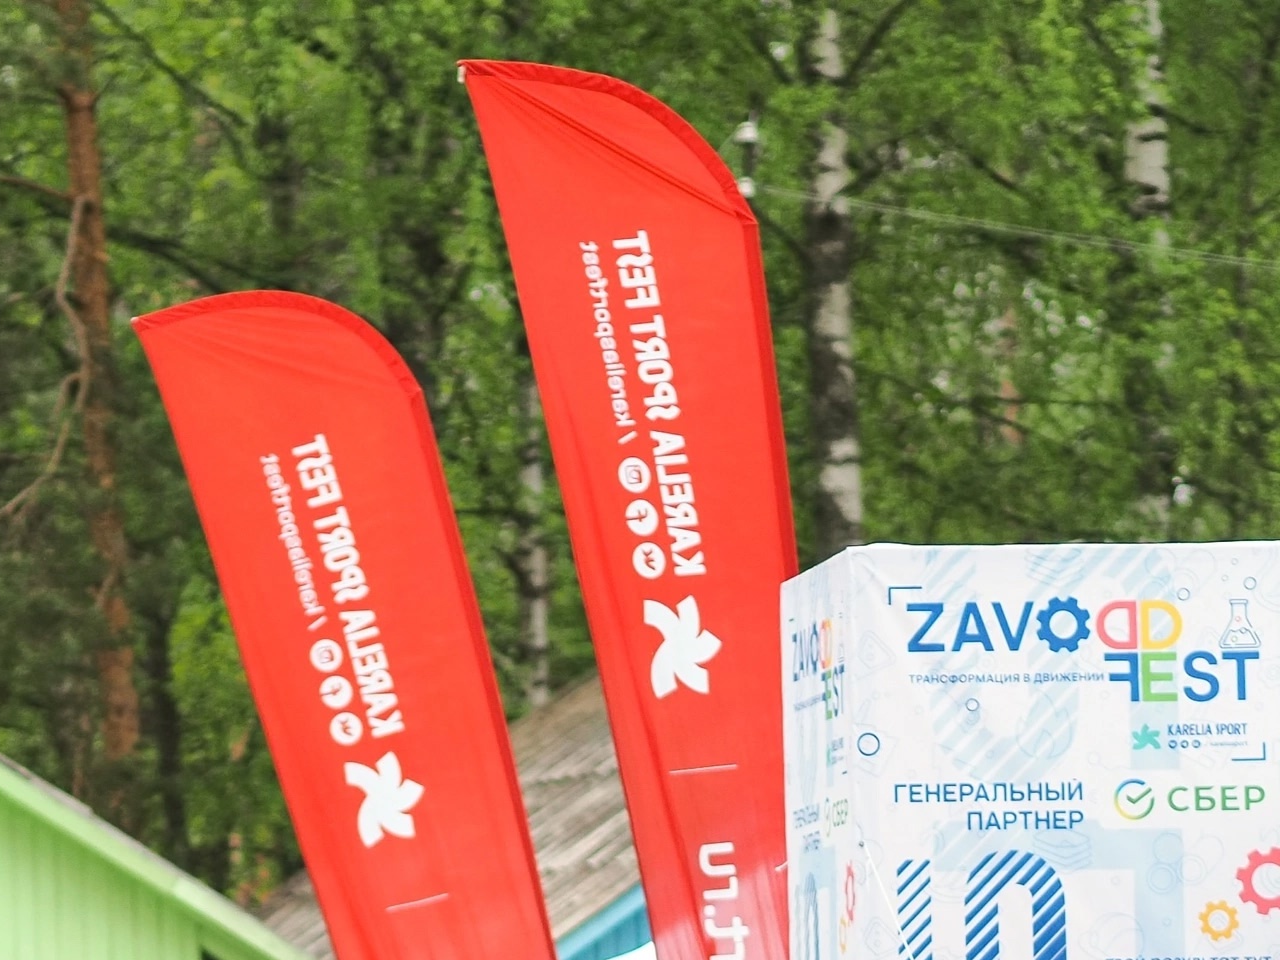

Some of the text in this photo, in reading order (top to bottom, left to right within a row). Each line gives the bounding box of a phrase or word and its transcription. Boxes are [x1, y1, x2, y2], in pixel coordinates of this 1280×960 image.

[909, 672, 1105, 684] ТРАНСФОРМАЦИЯ В ДВИЖЕНИИ
[1167, 722, 1248, 735] KARELIA SPORT
[894, 778, 1084, 804] ГЕНЕРАЛЬНЫЙ
[1167, 785, 1266, 812] СБЕР
[967, 810, 1084, 831] ПАРТНЕР
